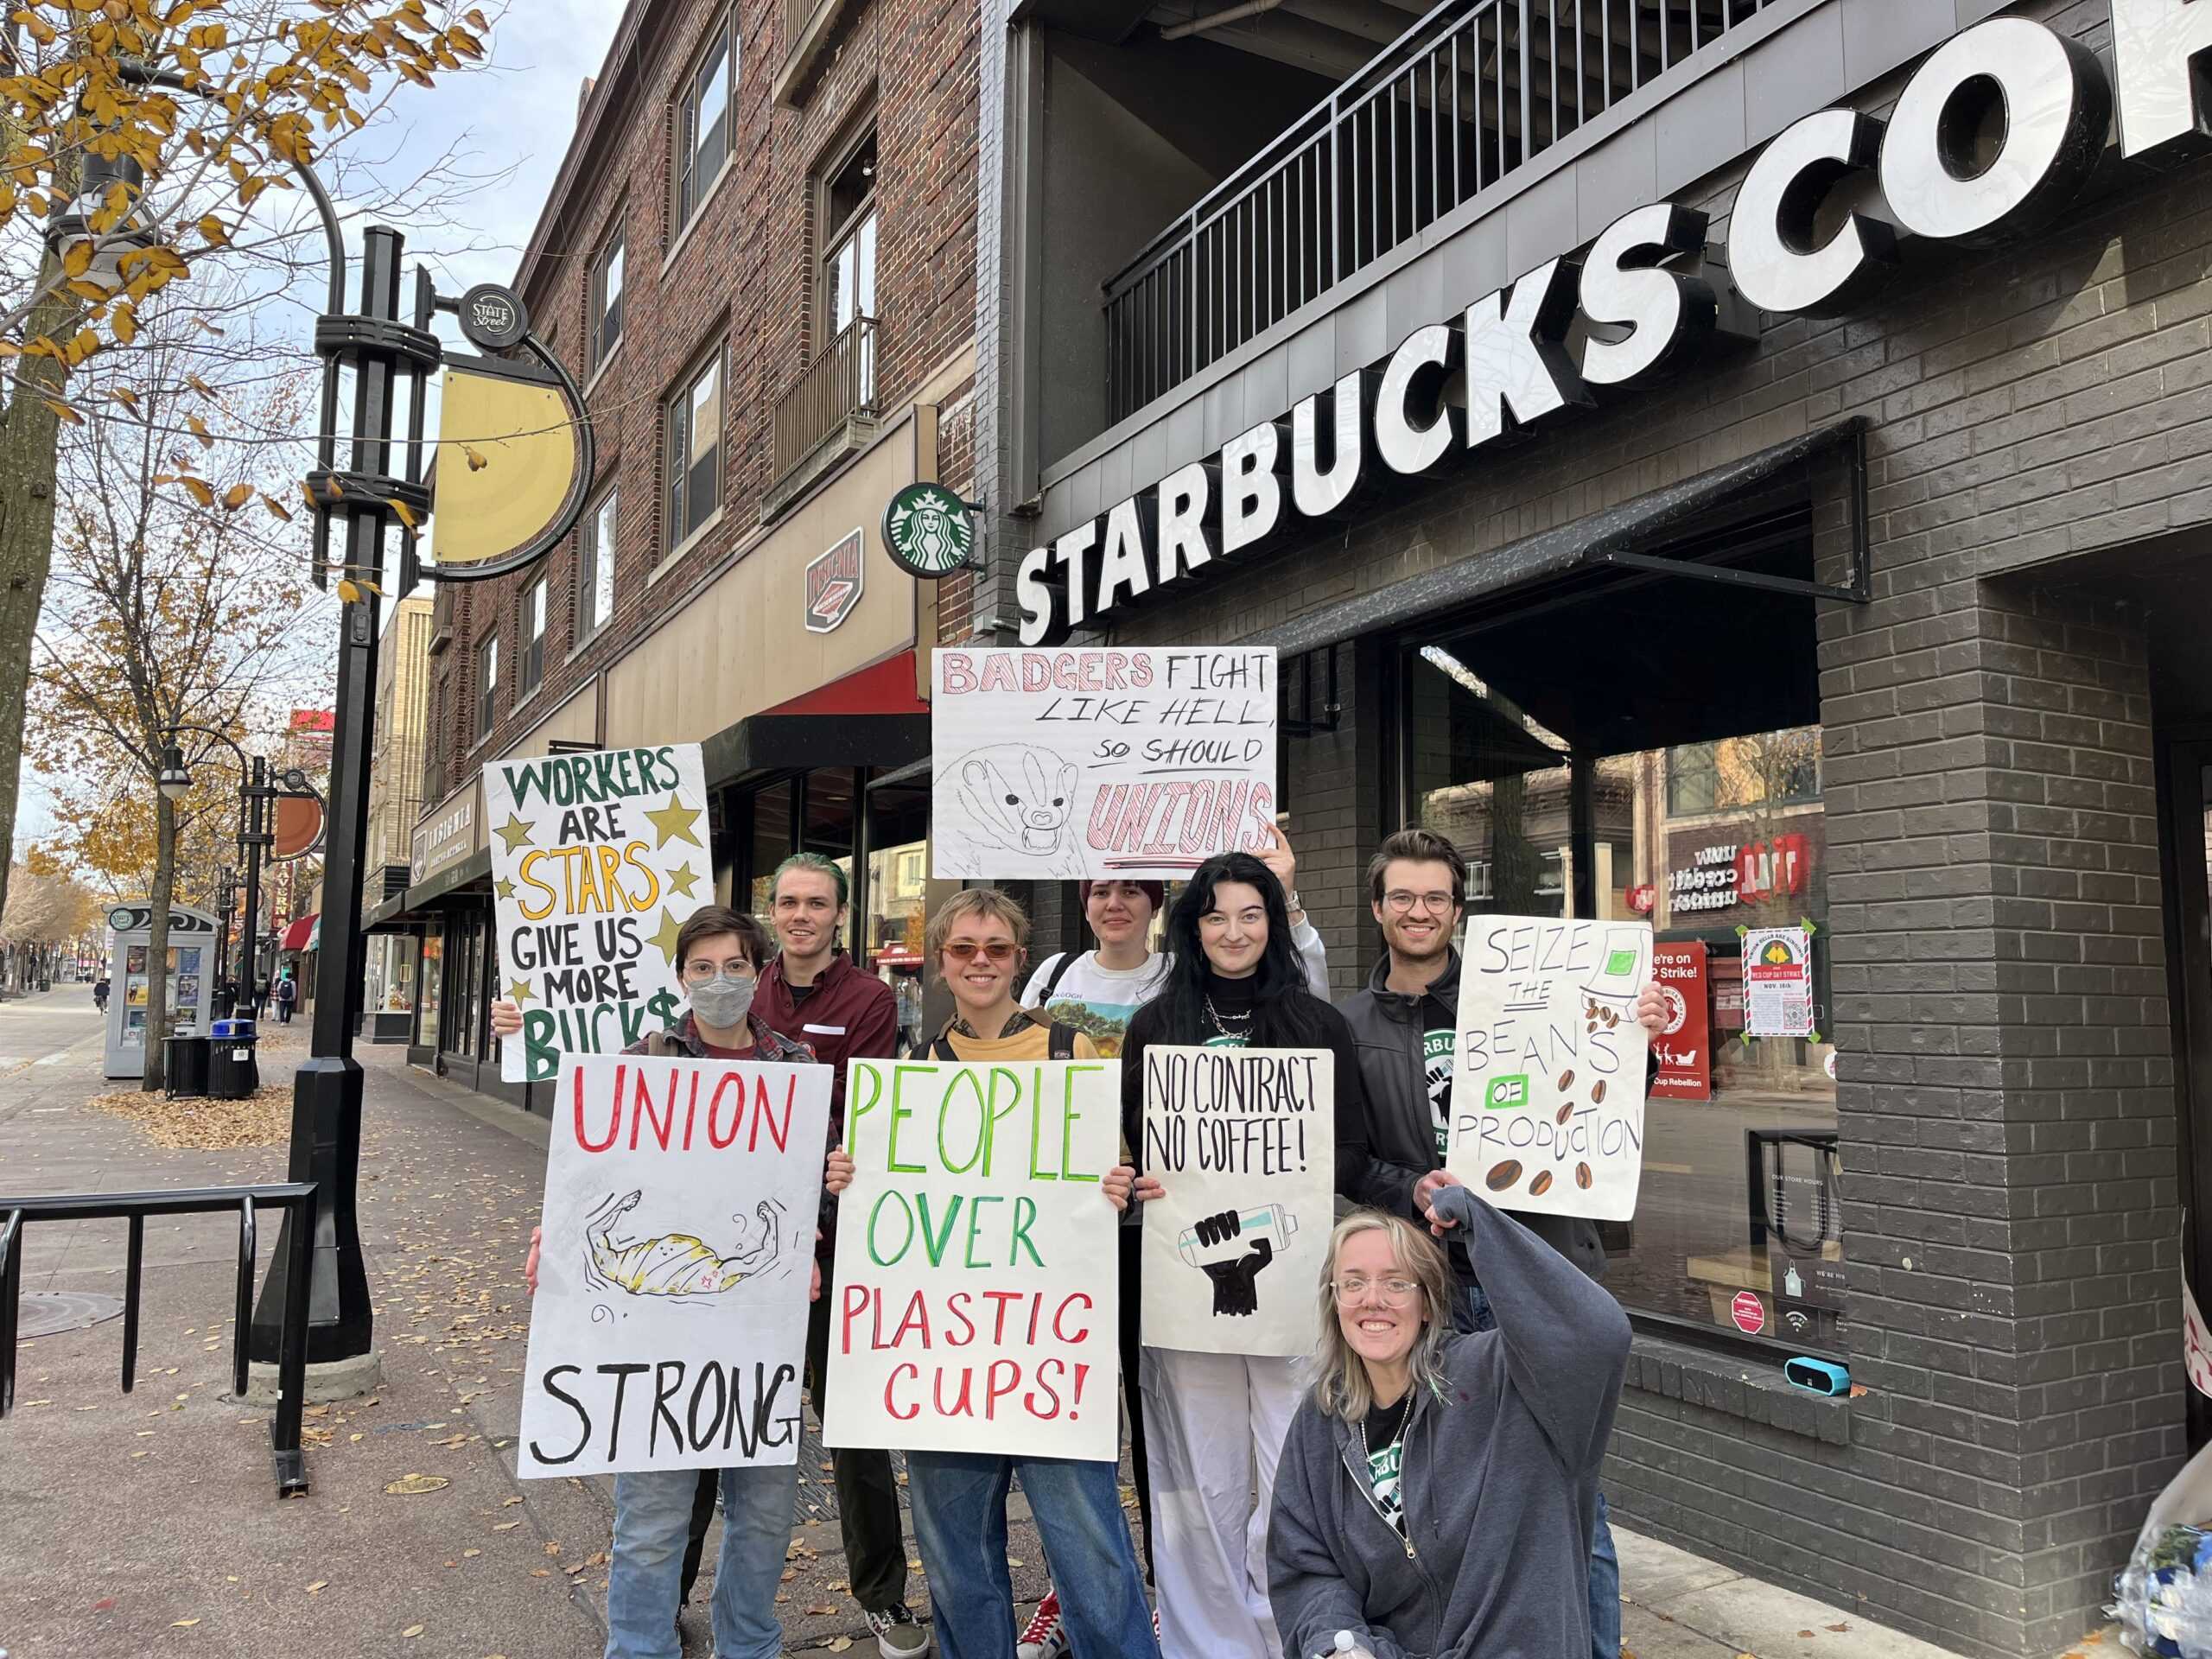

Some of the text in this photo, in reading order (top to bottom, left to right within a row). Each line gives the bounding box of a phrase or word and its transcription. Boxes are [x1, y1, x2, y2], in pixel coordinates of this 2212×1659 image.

[473, 302, 508, 321] STATE
[473, 315, 506, 327] Street
[1016, 202, 1685, 646] STARBUCKS
[808, 537, 858, 609] INSIGNIA
[942, 653, 1270, 694] BADGERS FIGHT
[1035, 697, 1276, 728] LIKE HELL,
[501, 747, 680, 812] WORKERS
[1092, 739, 1263, 766] SO SHOULD
[559, 803, 626, 845] ARE
[1086, 779, 1273, 855] UNIONS
[276, 861, 291, 915] TAVERN
[517, 841, 660, 921] STARS
[511, 917, 643, 970] GIVE US
[1480, 924, 1592, 975] SEIZE
[1676, 954, 1691, 964] on
[543, 961, 639, 1008] MORE
[1508, 980, 1554, 1001] THE
[1660, 966, 1697, 979] Strike!
[1465, 1019, 1620, 1075] BEANS
[573, 1064, 797, 1154] UNION
[1147, 1051, 1319, 1113] NO CONTRACT
[1492, 1081, 1522, 1107] OF
[1669, 1077, 1702, 1088] Rebellion
[847, 1062, 1105, 1182] PEOPLE
[1146, 1114, 1307, 1176] NO COFFEE!
[1456, 1107, 1641, 1163] PRODUCTION
[867, 1189, 1046, 1269] OVER
[842, 1284, 1093, 1355] PLASTIC
[529, 1360, 803, 1465] STRONG
[883, 1358, 1090, 1421] CUPS!
